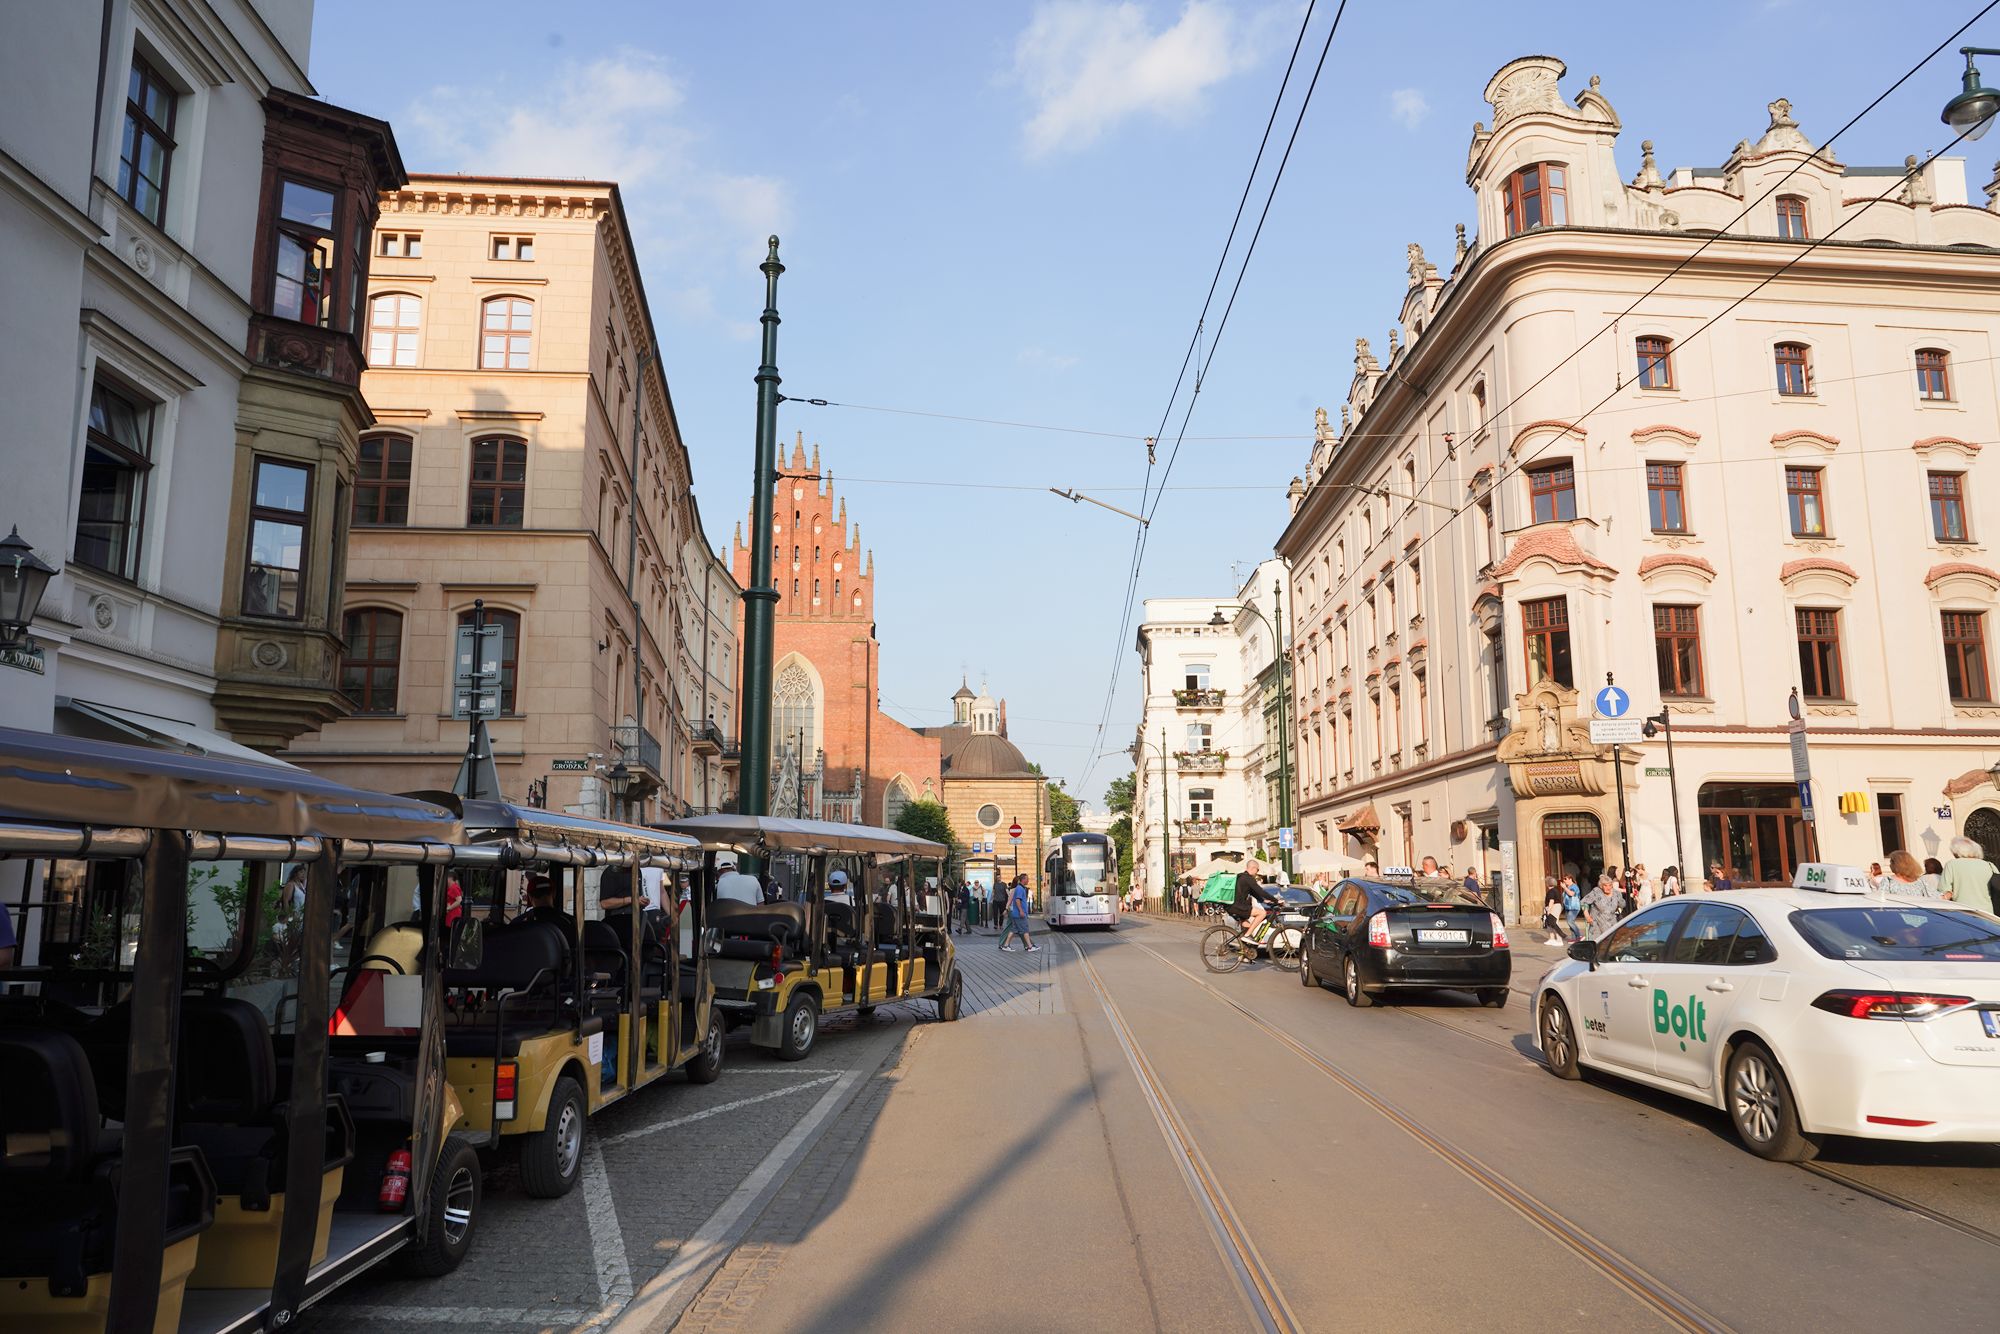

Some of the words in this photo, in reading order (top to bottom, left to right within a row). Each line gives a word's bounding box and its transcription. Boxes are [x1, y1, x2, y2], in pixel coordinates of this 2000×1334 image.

[1534, 776, 1577, 785] ANTONI
[1940, 808, 1950, 817] 26
[1806, 867, 1826, 883] Bolt
[1843, 877, 1865, 888] TAXI
[1423, 931, 1435, 939] KK
[1653, 988, 1707, 1043] Bolt
[1584, 1016, 1607, 1033] beter
